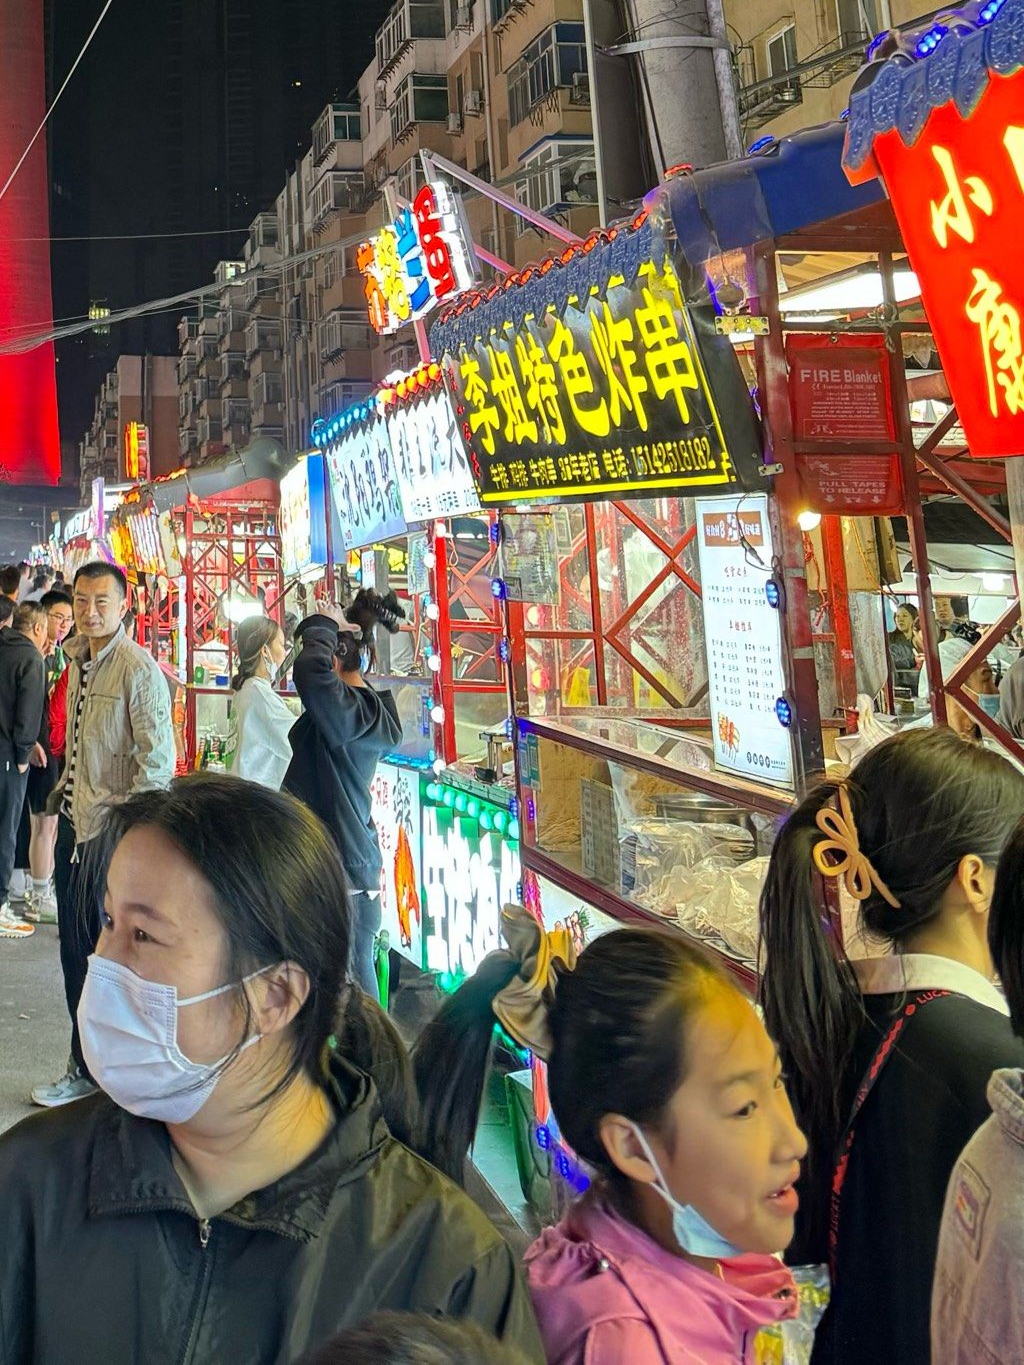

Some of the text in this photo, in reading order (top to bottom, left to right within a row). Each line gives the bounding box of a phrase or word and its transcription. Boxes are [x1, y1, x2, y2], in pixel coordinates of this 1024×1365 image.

[929, 145, 994, 249] 小
[460, 288, 699, 456] 李姐特色炸串
[800, 369, 883, 384] FIRE Blanket
[528, 455, 558, 486] 牛肉串
[630, 436, 716, 476] 15142518182
